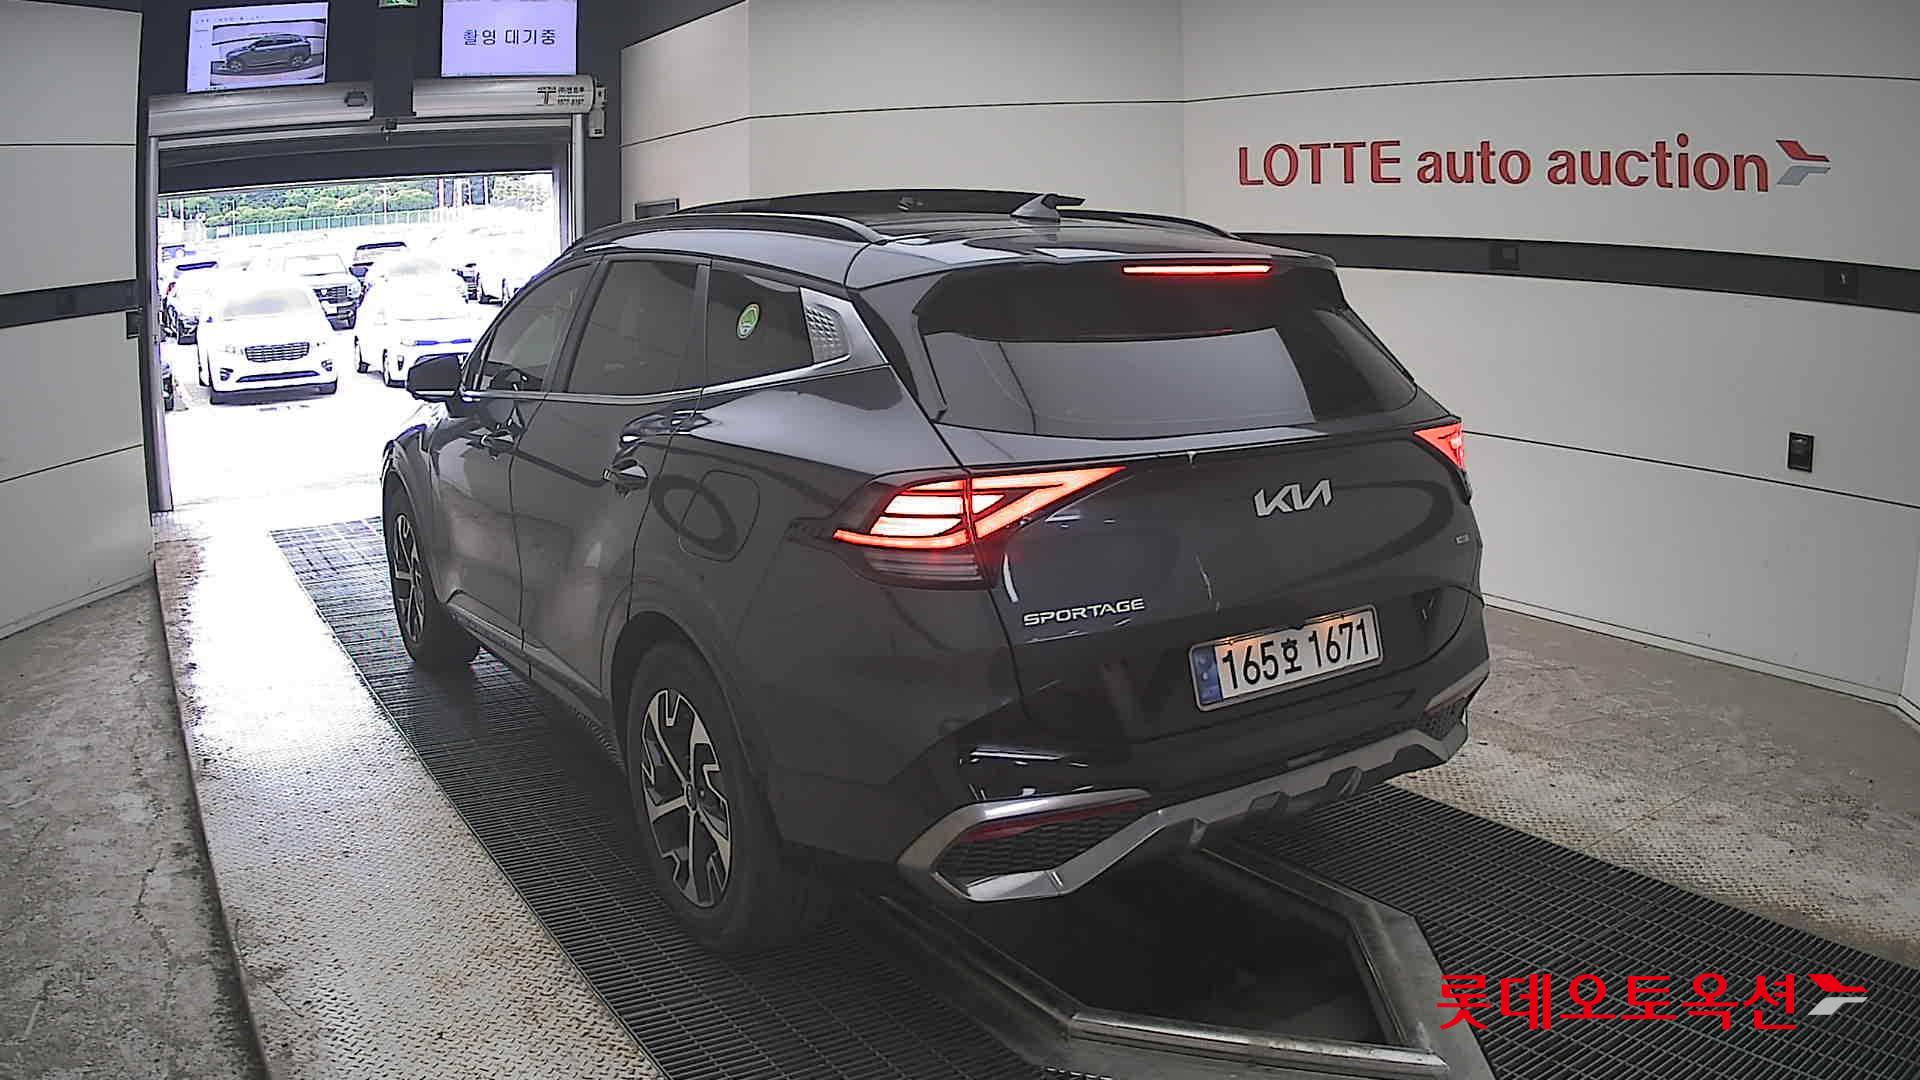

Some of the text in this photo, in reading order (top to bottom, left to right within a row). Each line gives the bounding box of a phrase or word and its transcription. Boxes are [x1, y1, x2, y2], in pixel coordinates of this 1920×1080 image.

[504, 28, 556, 46] 대기중
[1239, 132, 1769, 193] LOTTE auto auction
[1254, 478, 1333, 518] KIA
[1023, 598, 1146, 627] SPORTAGE
[1222, 617, 1369, 690] 165호 1671
